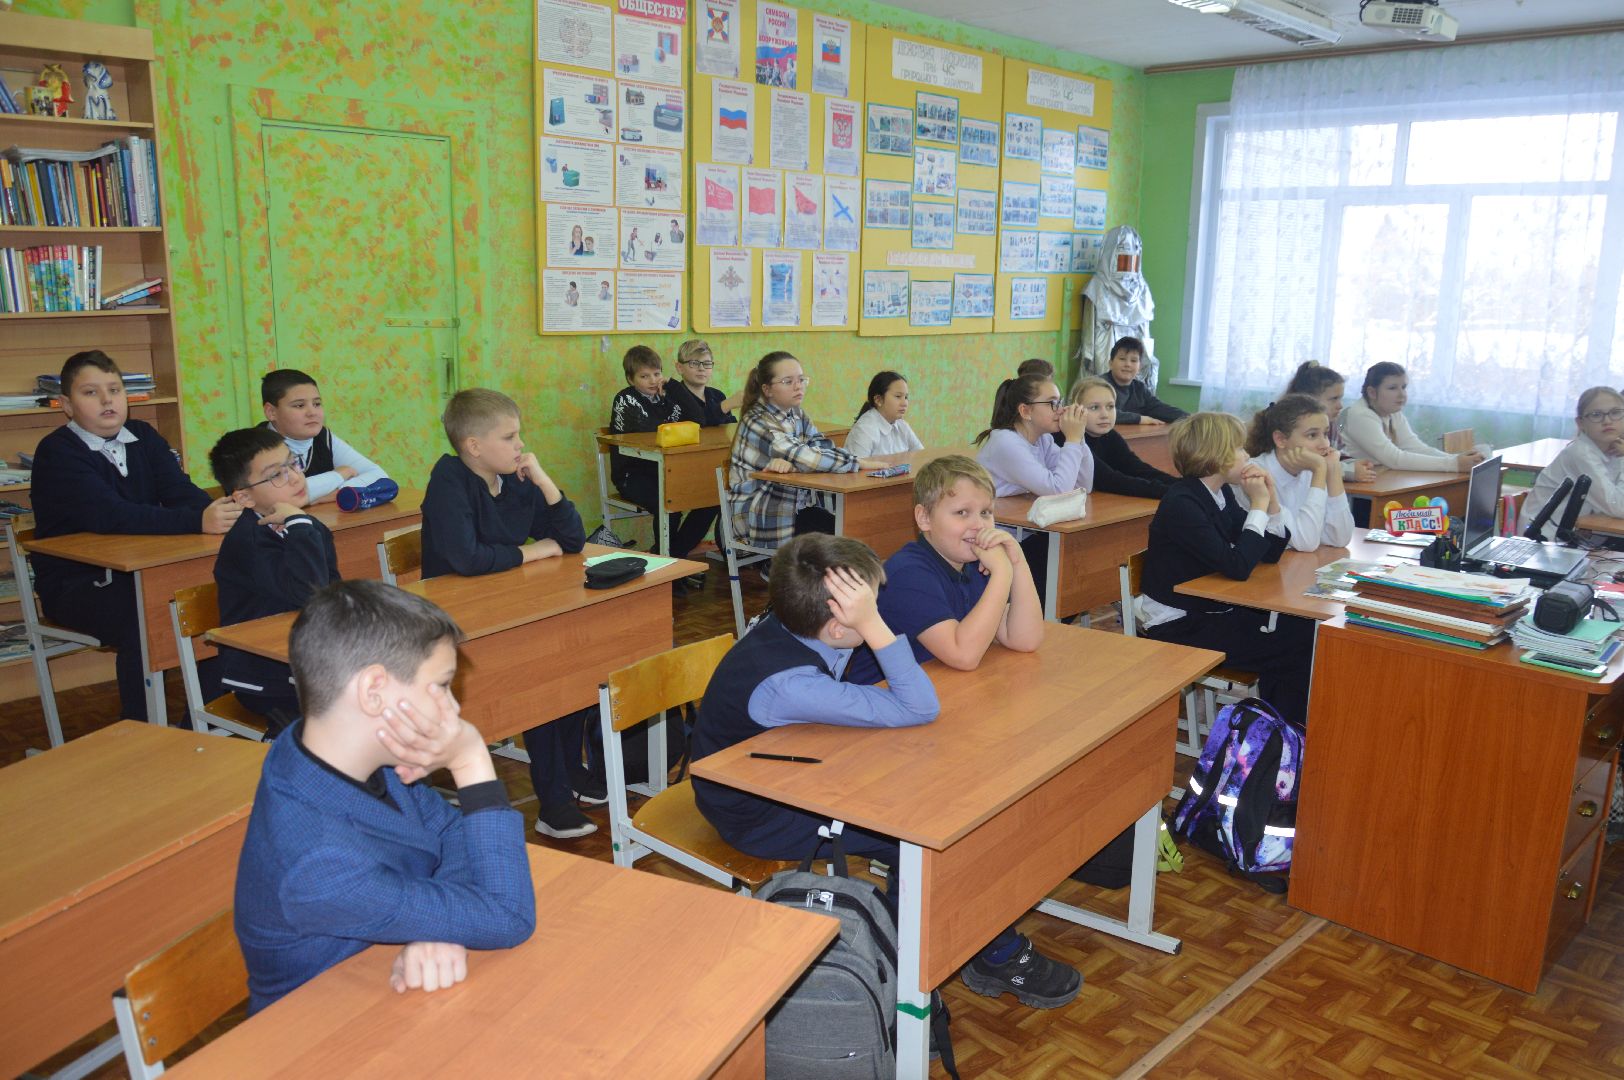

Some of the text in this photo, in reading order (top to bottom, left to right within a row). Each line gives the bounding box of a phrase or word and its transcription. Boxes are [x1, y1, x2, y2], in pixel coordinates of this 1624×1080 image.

[619, 0, 685, 20] ОБЩЕСТВУ
[942, 63, 956, 76] ЧС
[1063, 89, 1074, 101] ЧС
[1393, 509, 1433, 520] Любимый
[1398, 517, 1441, 531] КЛАСС!
